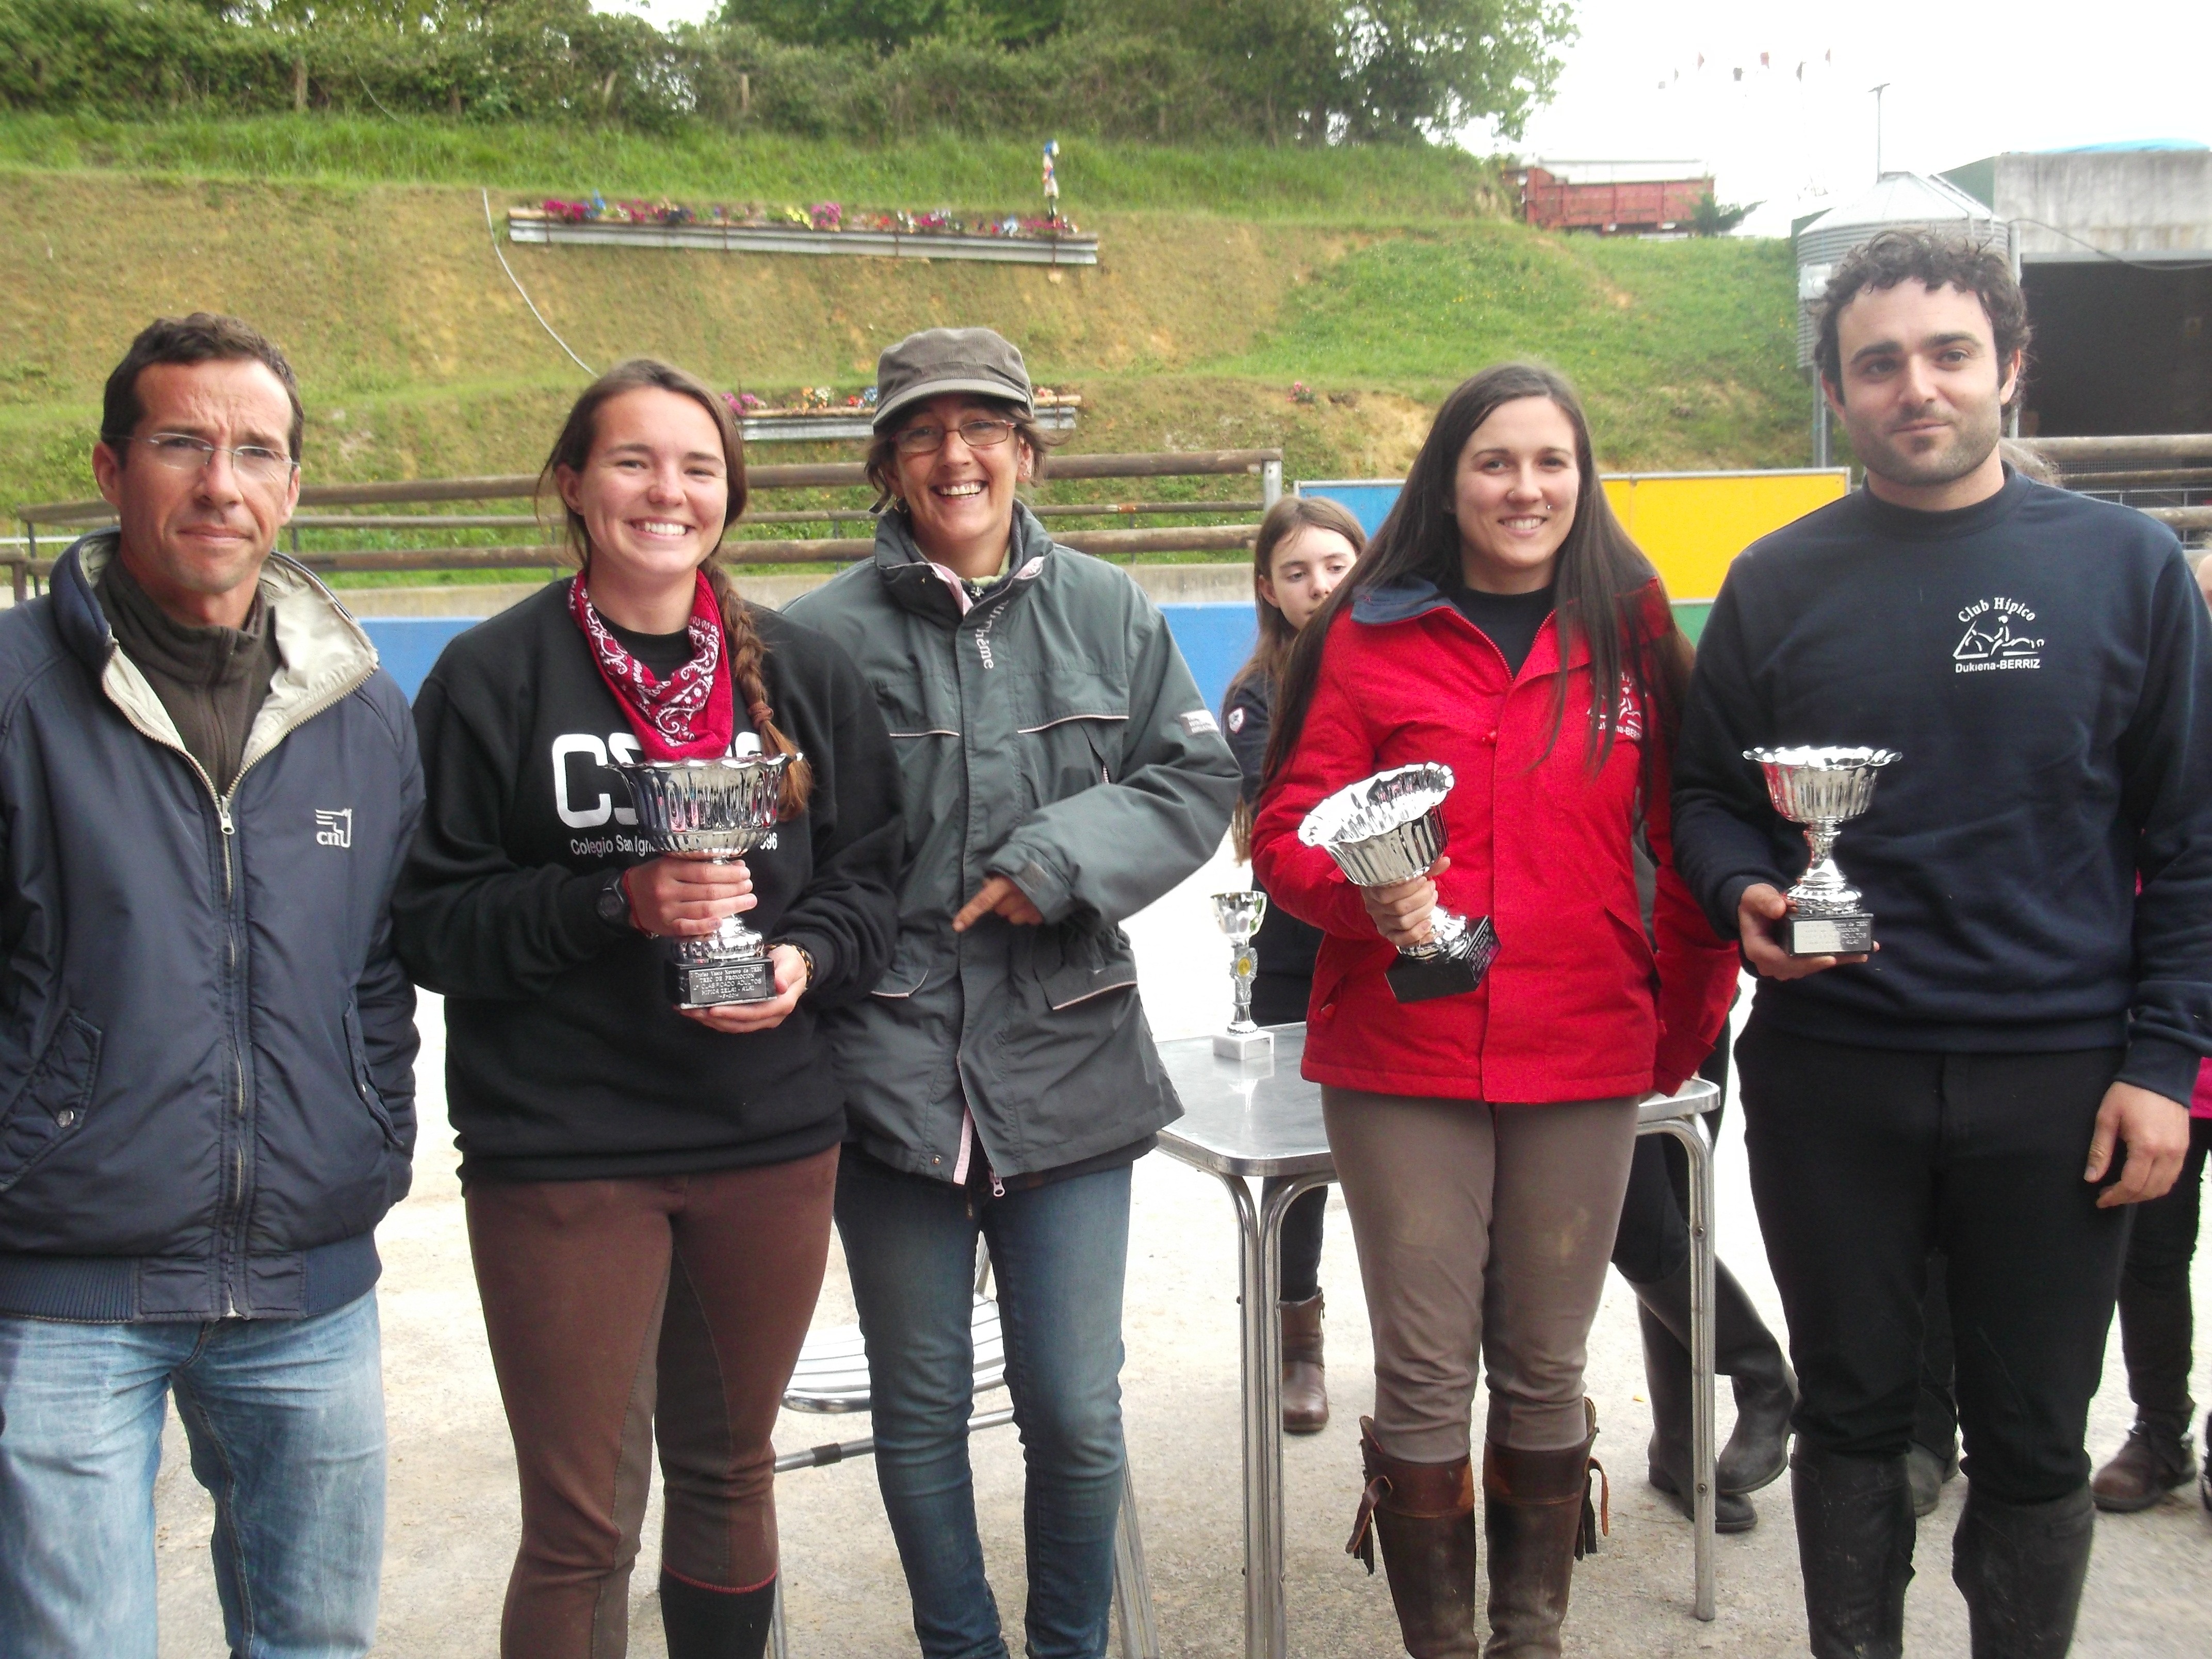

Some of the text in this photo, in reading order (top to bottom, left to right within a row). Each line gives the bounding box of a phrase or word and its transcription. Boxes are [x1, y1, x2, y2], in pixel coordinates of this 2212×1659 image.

[1958, 597, 2036, 622] Club Hípico
[570, 837, 614, 857] Colegio
[616, 834, 634, 852] San
